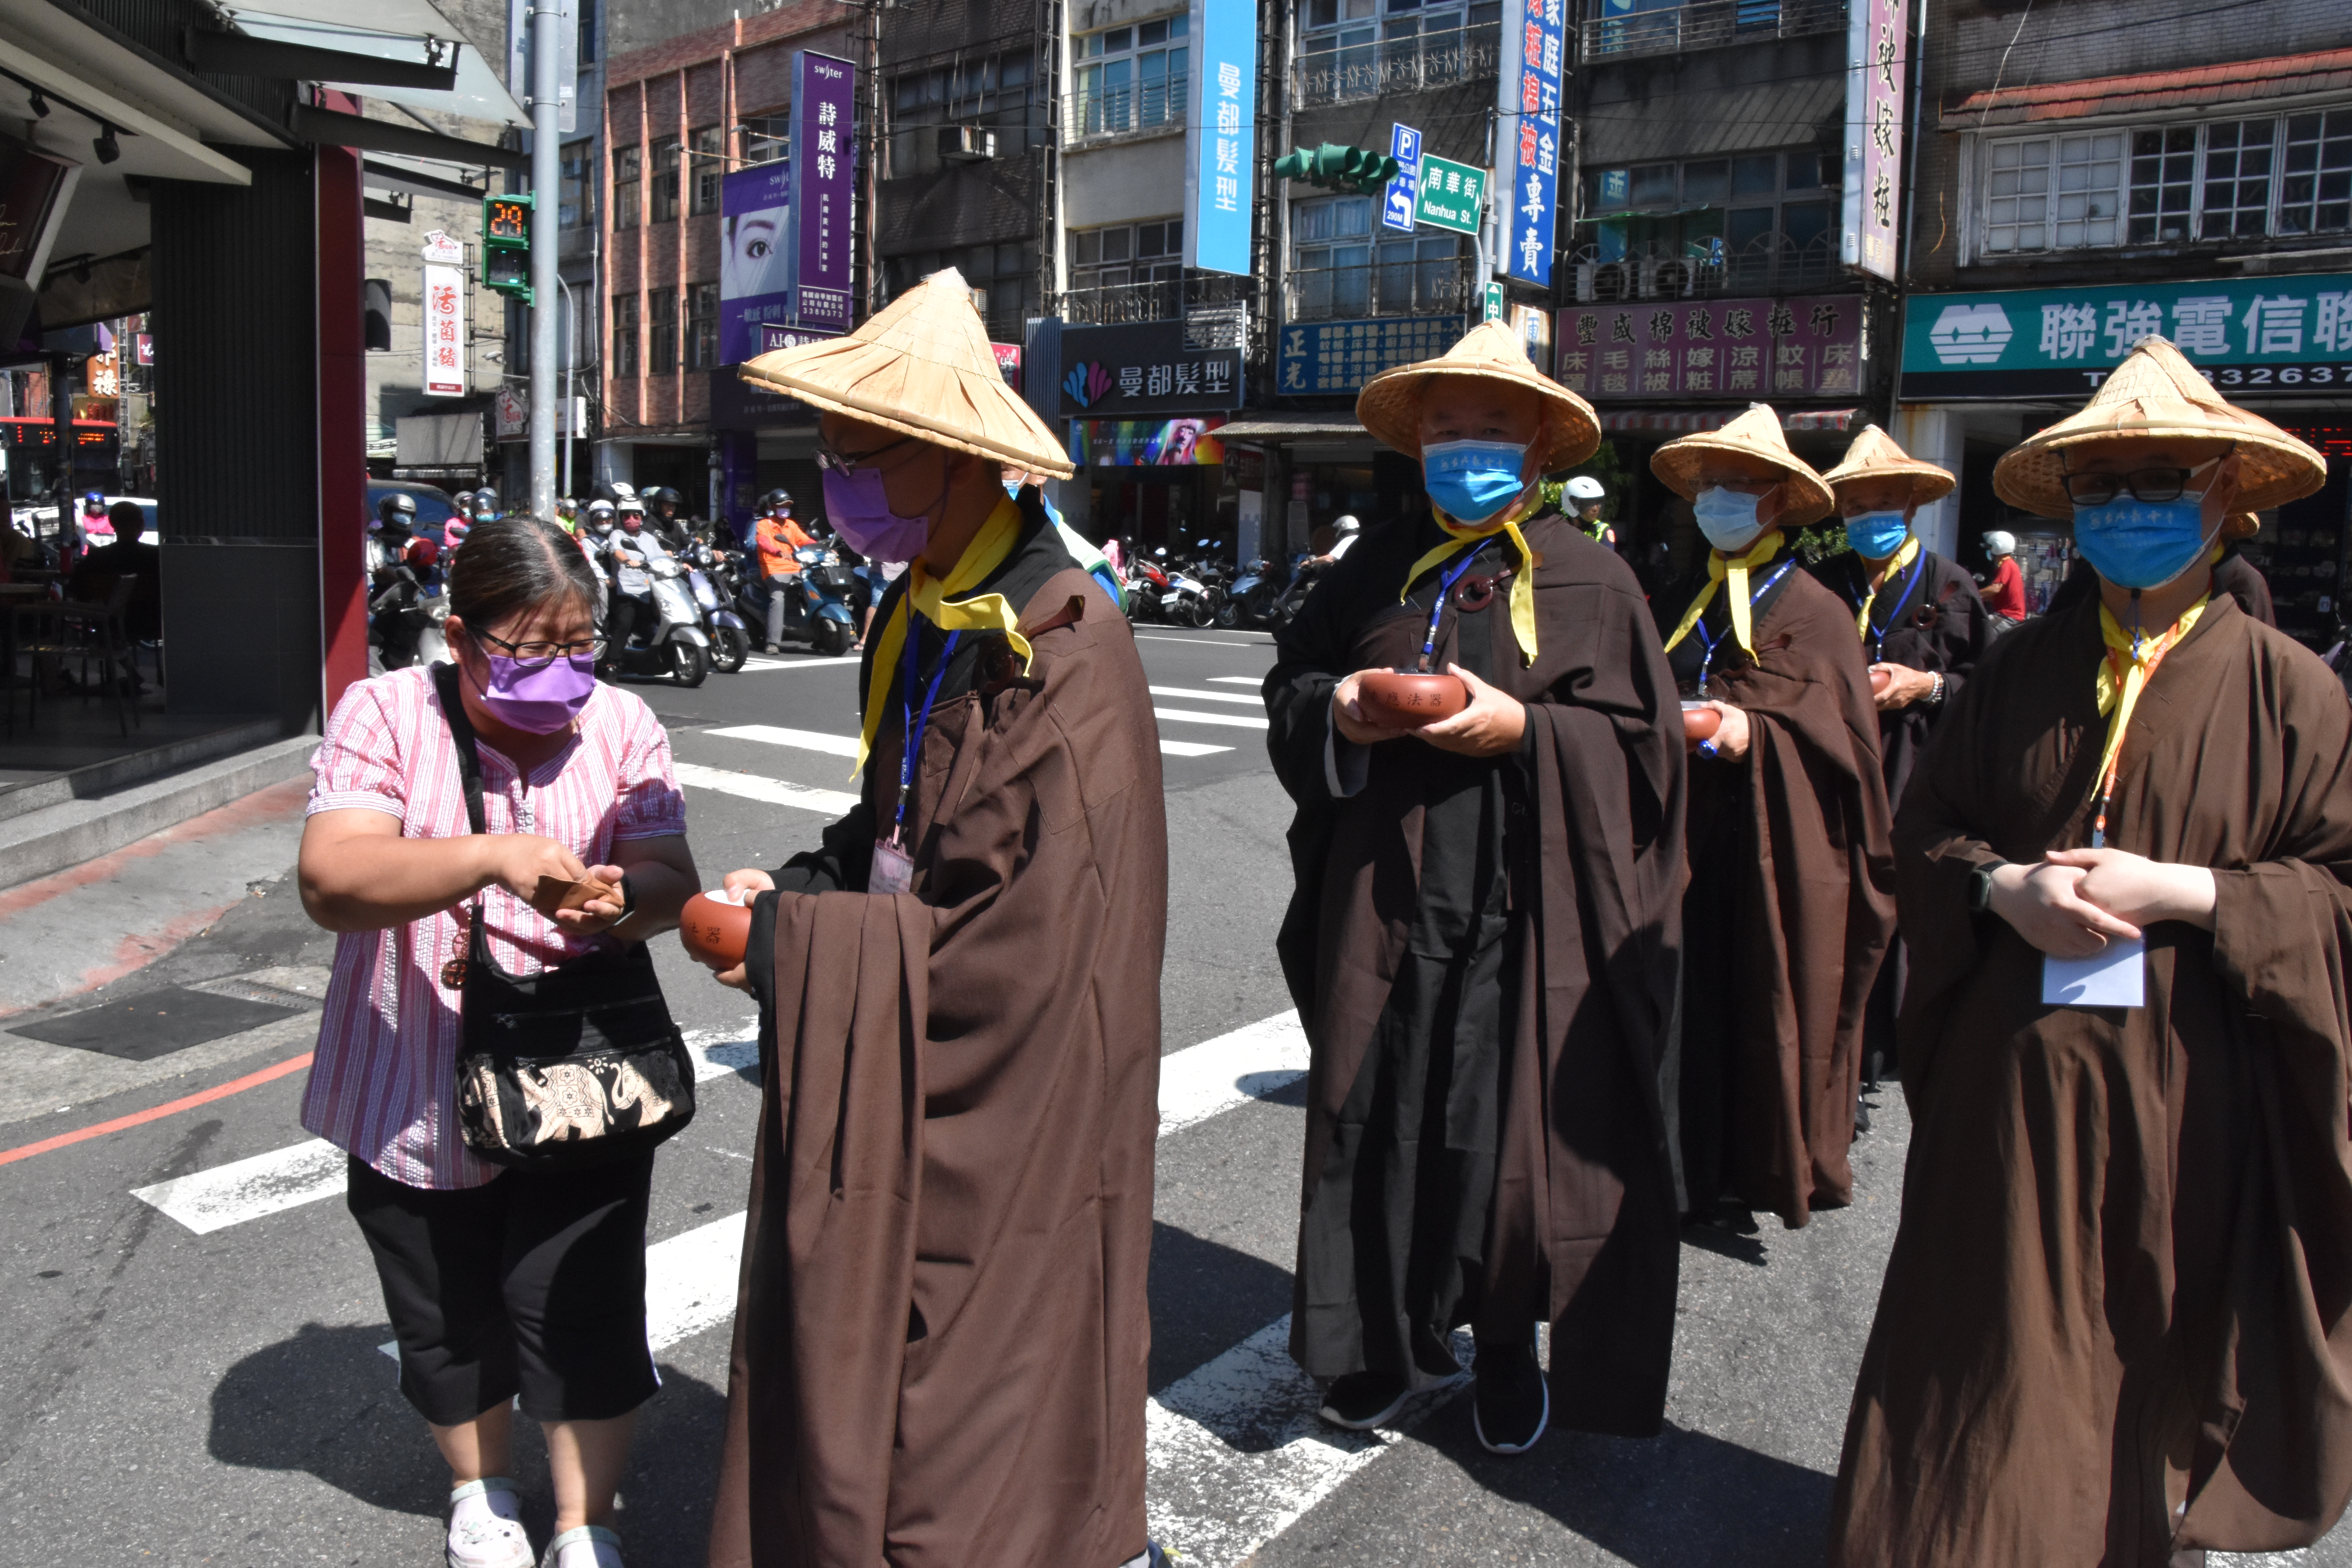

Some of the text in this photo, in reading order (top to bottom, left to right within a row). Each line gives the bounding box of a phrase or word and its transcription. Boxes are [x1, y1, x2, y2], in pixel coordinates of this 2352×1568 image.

[1538, 0, 1561, 175] 家庭五金
[817, 102, 837, 180] 詩威特
[1215, 62, 1241, 212] 曼都髮型
[1400, 132, 1412, 154] P
[1397, 161, 1416, 176] 門公園
[1428, 167, 1477, 199] 南華街
[490, 203, 521, 235] 29
[1387, 211, 1403, 223] 290M
[1424, 200, 1472, 225] Nanhua St.
[1520, 173, 1544, 276] 專賣
[803, 307, 842, 318] 3389373
[2039, 291, 2352, 361] 聯強電信聯
[1284, 329, 1307, 389] 正光
[1119, 360, 1230, 397] 曼都髮型
[2154, 642, 2168, 661] ENJOY
